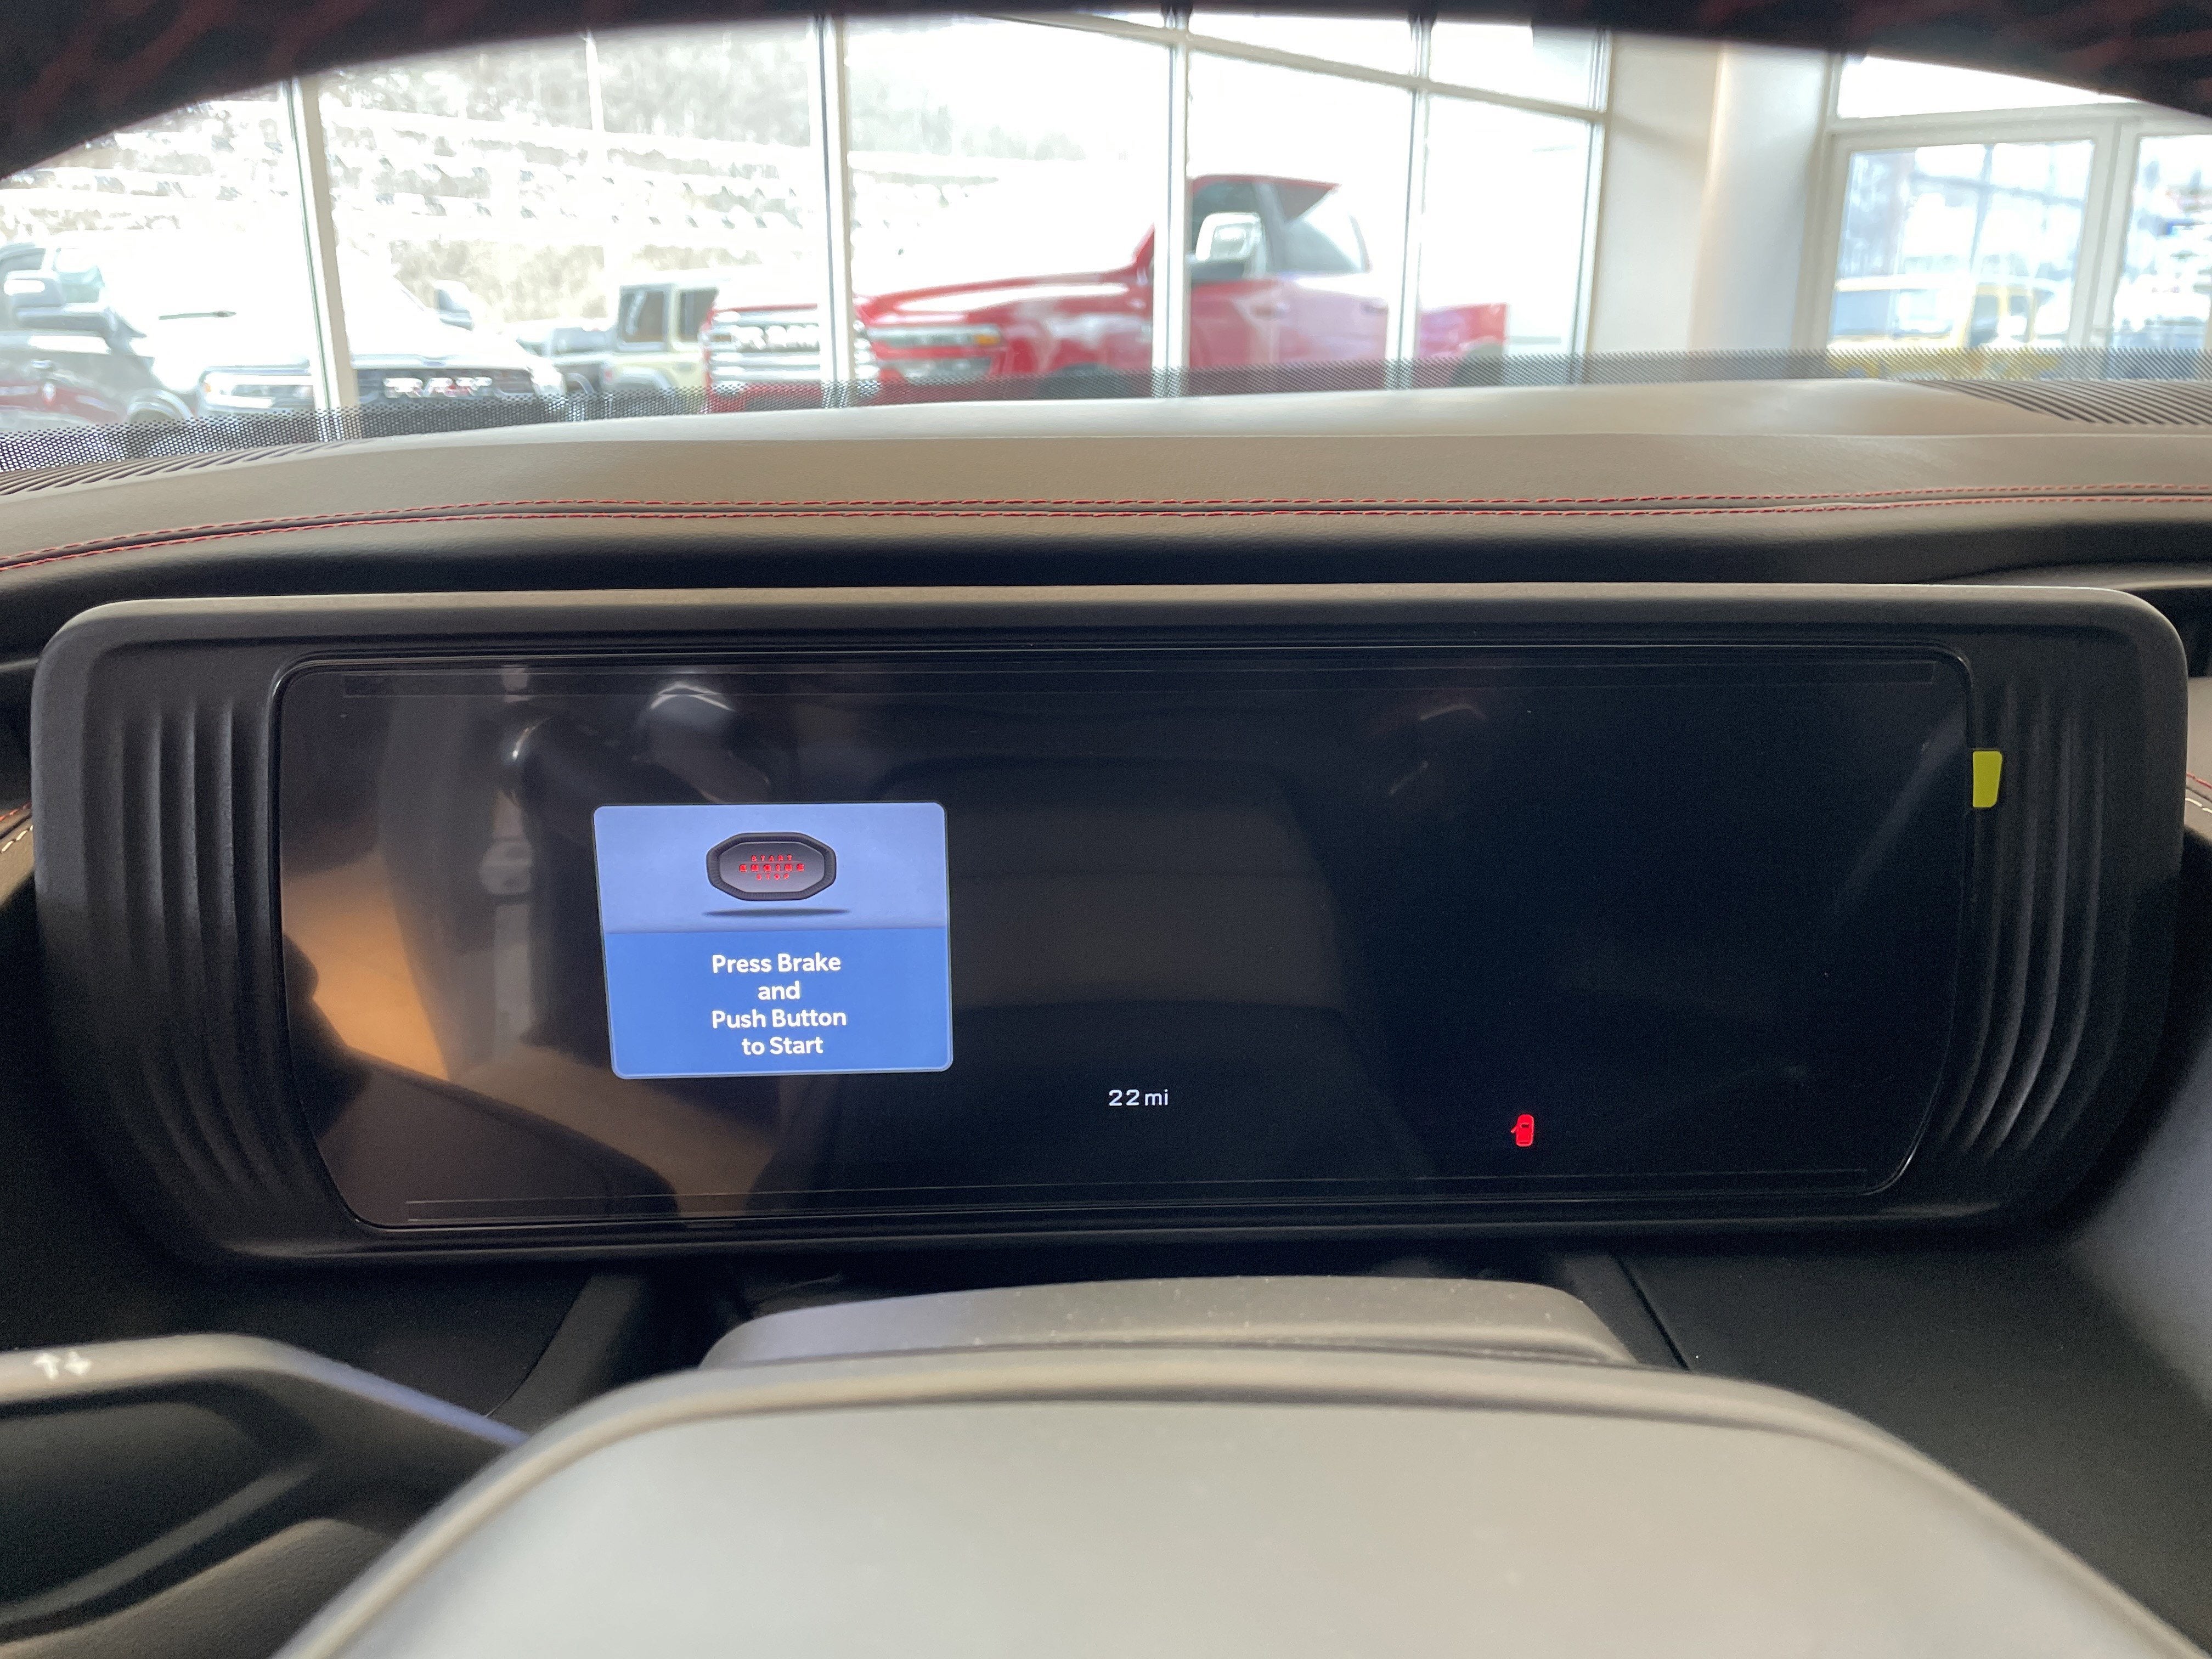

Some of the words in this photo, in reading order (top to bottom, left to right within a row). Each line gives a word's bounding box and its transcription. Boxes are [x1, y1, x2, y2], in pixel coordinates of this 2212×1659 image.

[739, 864, 805, 872] ENGINE
[712, 955, 772, 973] Press
[777, 952, 841, 972] Brake
[758, 980, 800, 1000] and
[712, 1009, 766, 1029] Push
[772, 1009, 847, 1028] Button
[741, 1038, 765, 1056] to
[770, 1036, 823, 1054] Start
